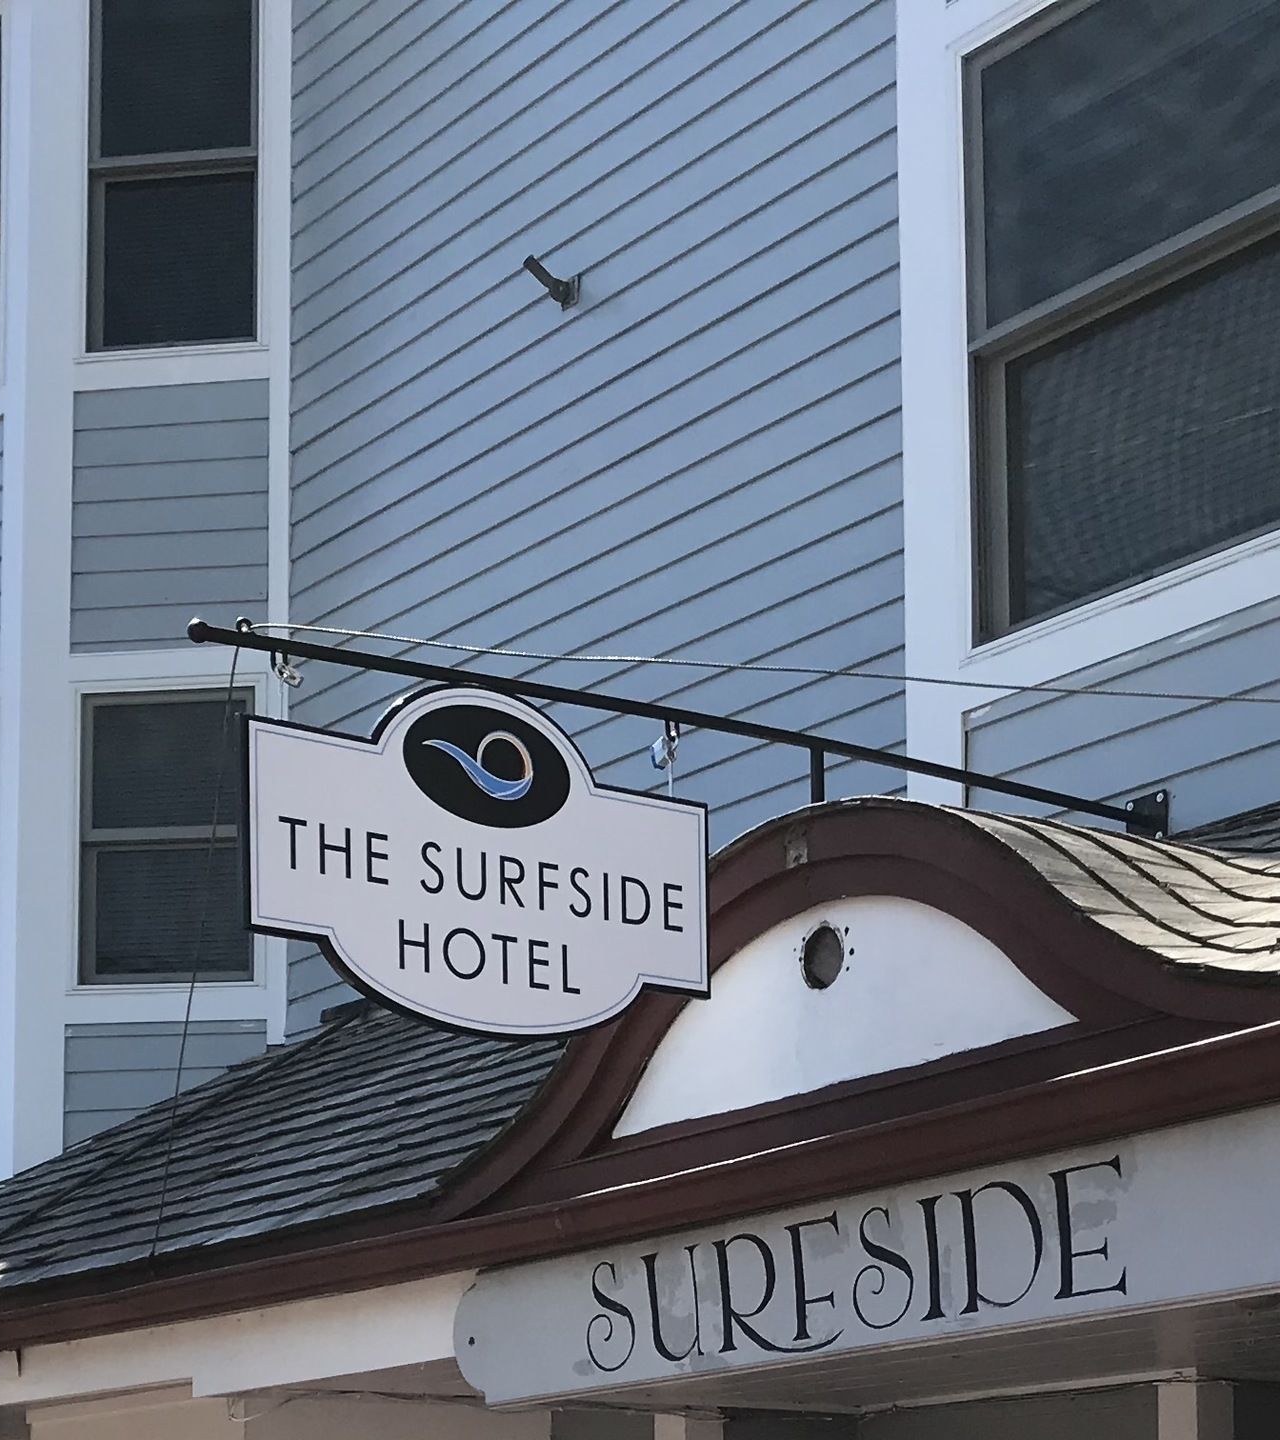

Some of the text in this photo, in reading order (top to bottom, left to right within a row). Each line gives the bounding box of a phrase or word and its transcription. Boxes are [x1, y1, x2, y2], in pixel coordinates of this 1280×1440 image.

[278, 816, 684, 932] THE SURFSIDE
[399, 919, 581, 995] HOTEL
[586, 1155, 1127, 1374] SURFSIDE
